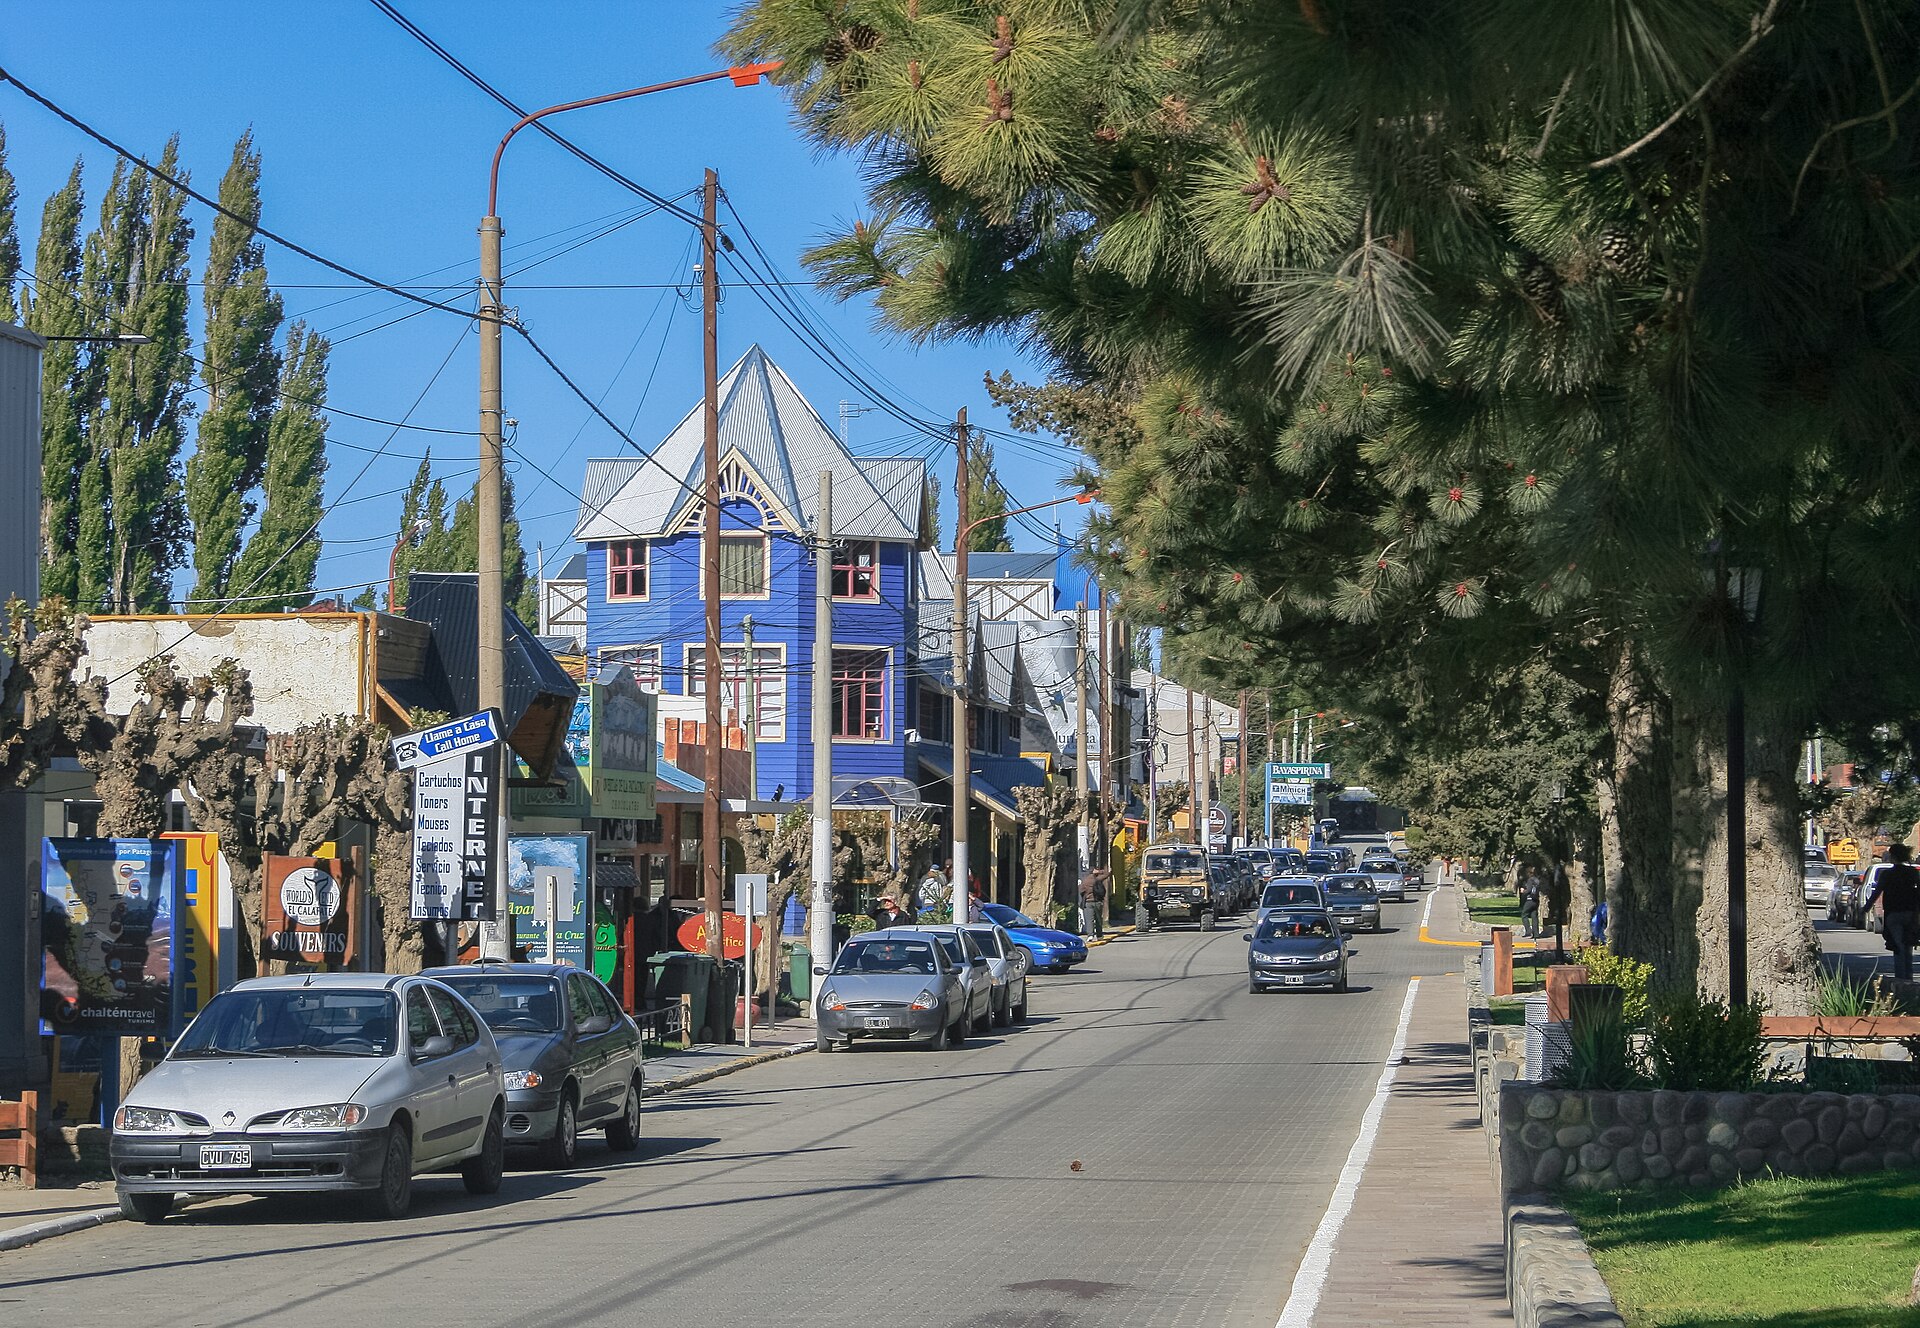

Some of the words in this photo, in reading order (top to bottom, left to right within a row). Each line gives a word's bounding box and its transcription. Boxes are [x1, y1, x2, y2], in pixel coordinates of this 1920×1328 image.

[424, 728, 453, 743] Llame
[455, 726, 462, 734] a
[463, 719, 486, 731] Casa
[434, 739, 453, 753] Call
[455, 733, 480, 745] Home
[1272, 765, 1323, 777] BAYASPIRINA
[419, 772, 462, 788] Cartuchos
[419, 792, 448, 809] Toners
[418, 814, 449, 830] Mouses
[417, 836, 454, 852] Teclados
[465, 756, 488, 919] INTERNET
[416, 858, 451, 874] Servicio
[288, 906, 295, 914] EL
[297, 906, 333, 916] CALAFATE
[414, 901, 449, 917] Insumos
[271, 932, 346, 953] SOUVENIRS
[81, 1007, 155, 1018] chalténtravel
[202, 1151, 223, 1164] CVU
[229, 1151, 249, 1164] 795
